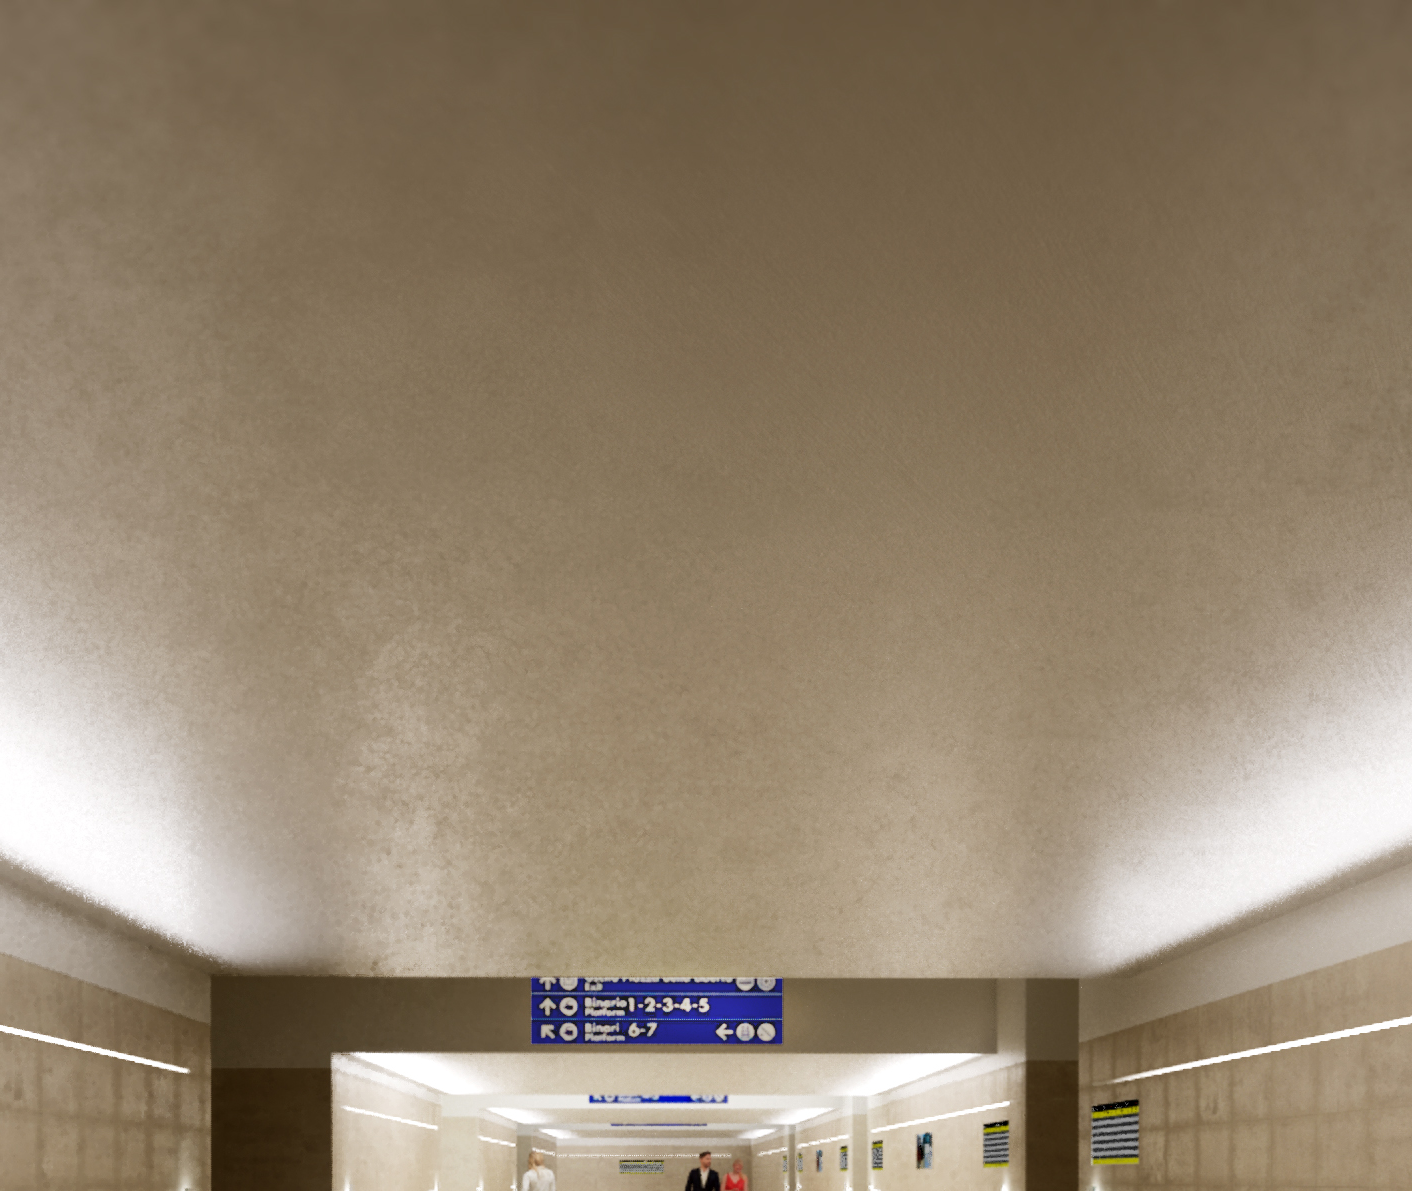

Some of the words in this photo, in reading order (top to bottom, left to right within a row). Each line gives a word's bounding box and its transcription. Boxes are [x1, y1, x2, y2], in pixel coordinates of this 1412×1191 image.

[584, 996, 628, 1008] Binario
[628, 997, 710, 1012] 1-2-3-4-5
[584, 1022, 620, 1033] Binari
[628, 1022, 658, 1037] 6-7
